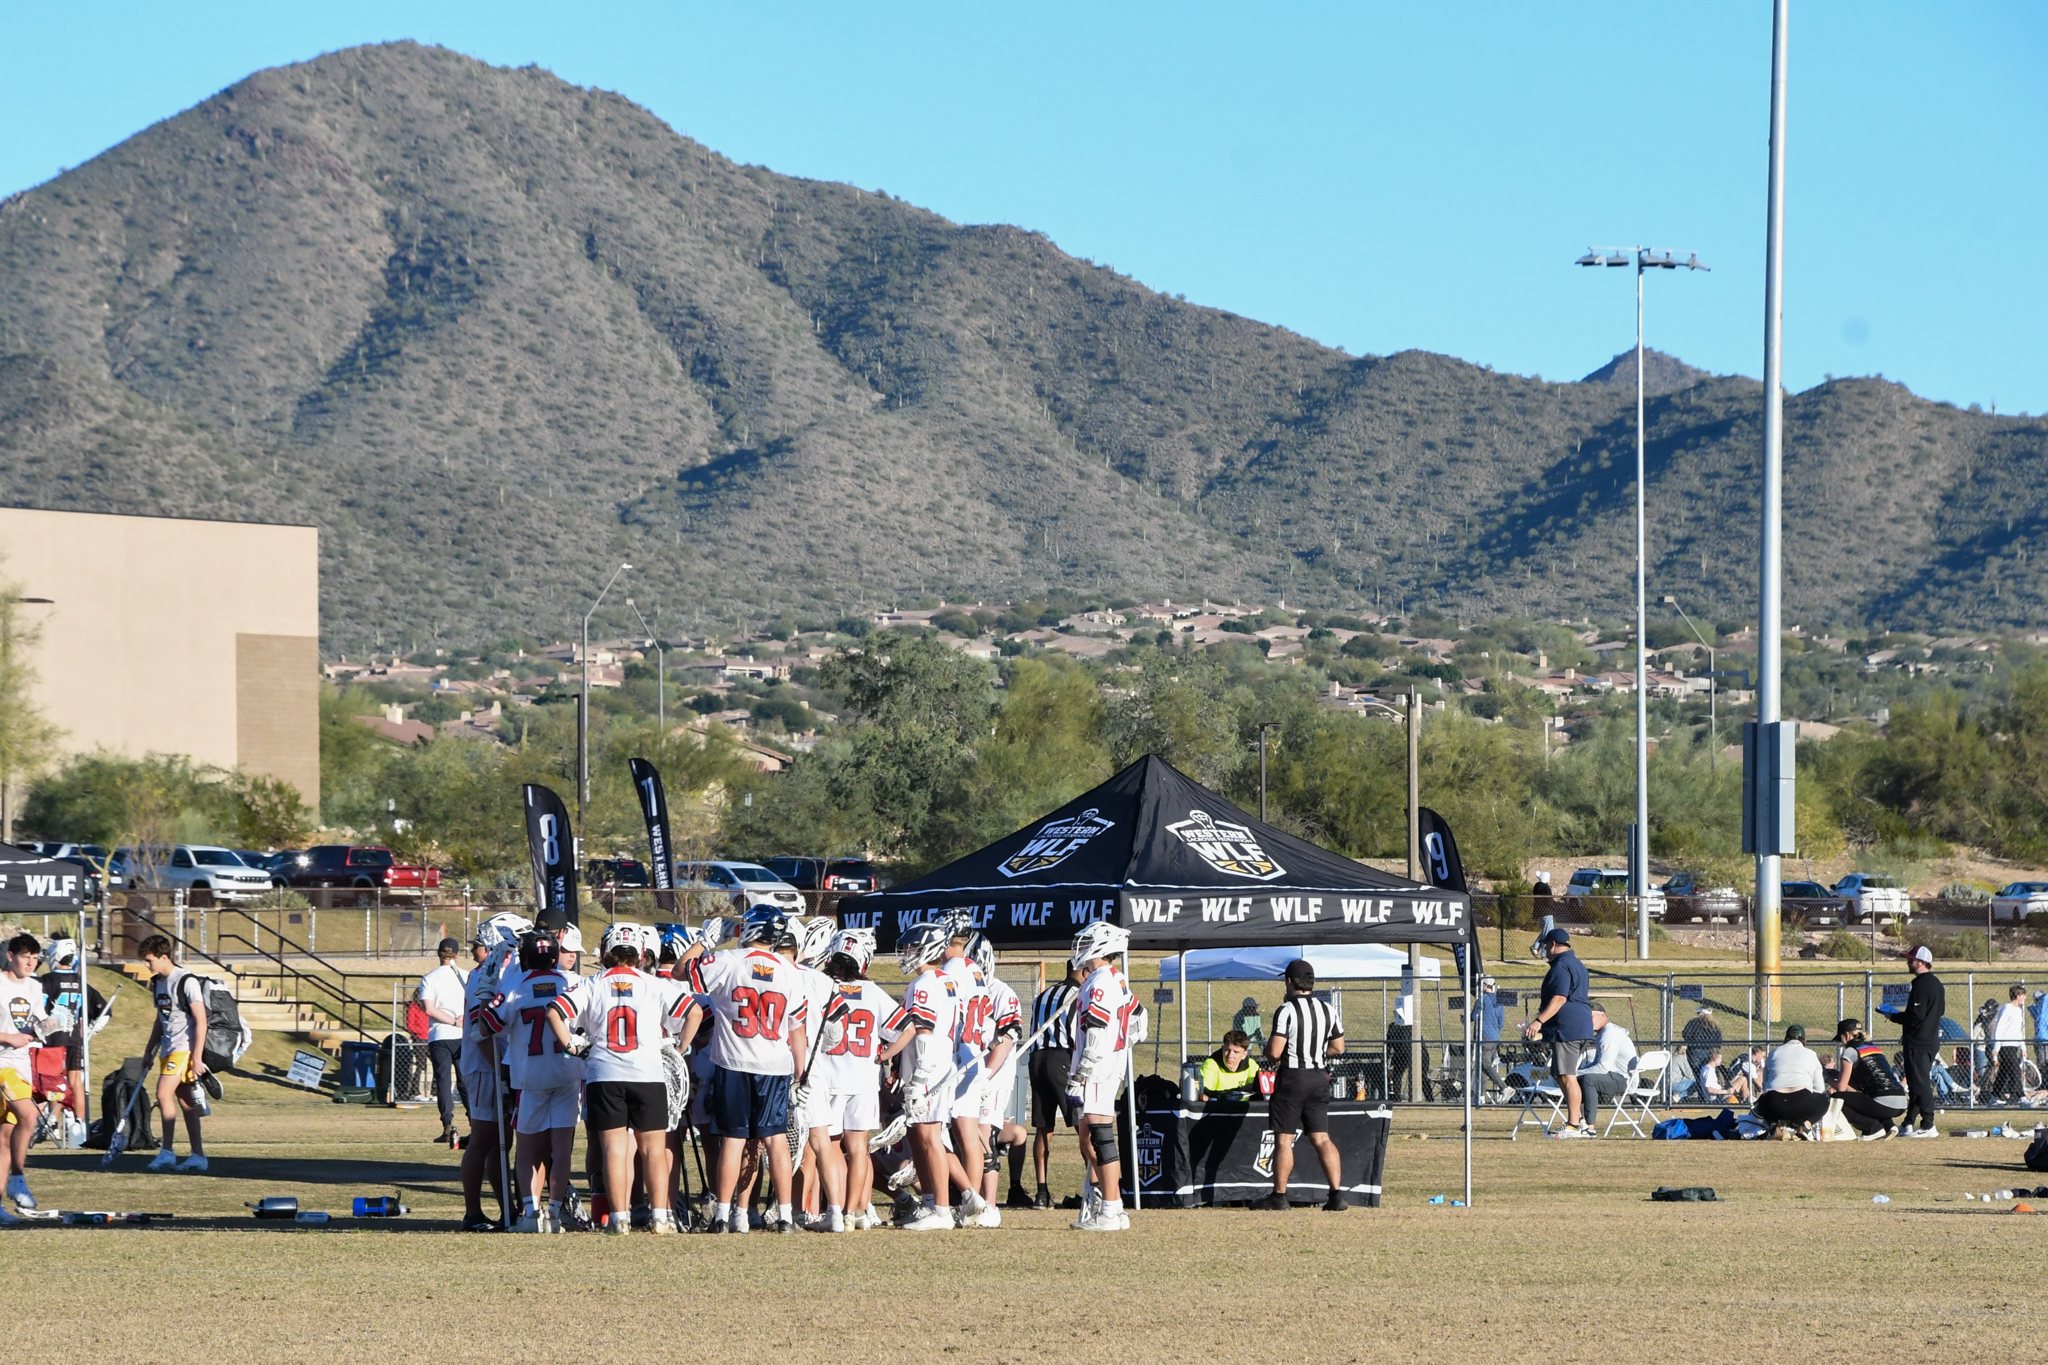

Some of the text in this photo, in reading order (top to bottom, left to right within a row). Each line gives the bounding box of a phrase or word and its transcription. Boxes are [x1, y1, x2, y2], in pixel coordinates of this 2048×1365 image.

[539, 813, 560, 866] 8
[1044, 826, 1101, 835] WESTERN
[1180, 829, 1248, 840] WESTERN
[652, 824, 670, 890] WESTERN
[1017, 838, 1090, 857] WLF
[1187, 842, 1267, 862] WLF
[1424, 831, 1449, 881] 9
[24, 874, 77, 897] WLF
[968, 904, 996, 929] LF
[1011, 902, 1054, 926] WLF
[1069, 899, 1114, 924] WLF
[1129, 897, 1464, 926] WLF WLF WLF WLF WLF
[731, 985, 788, 1042] 30
[607, 1005, 639, 1053] 0
